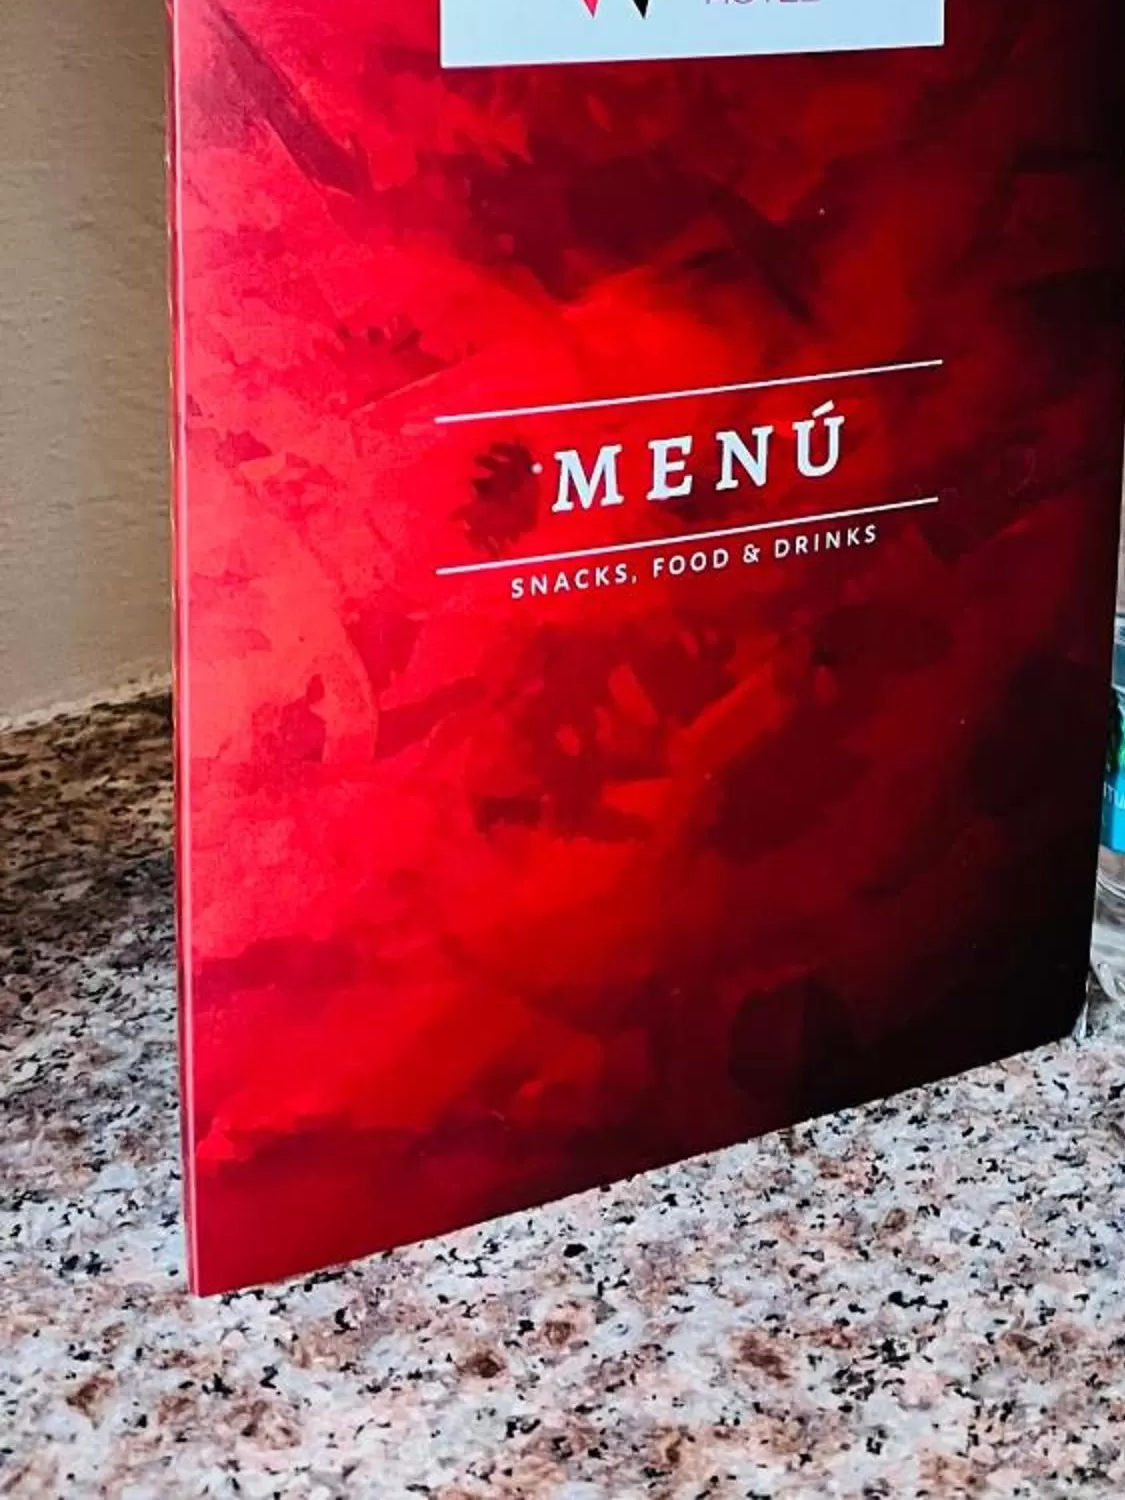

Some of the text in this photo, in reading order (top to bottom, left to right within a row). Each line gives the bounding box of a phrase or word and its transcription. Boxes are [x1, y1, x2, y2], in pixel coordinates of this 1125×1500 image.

[551, 399, 845, 513] MENÚ
[511, 524, 878, 599] SNACKS, FOOD & DRINKS
